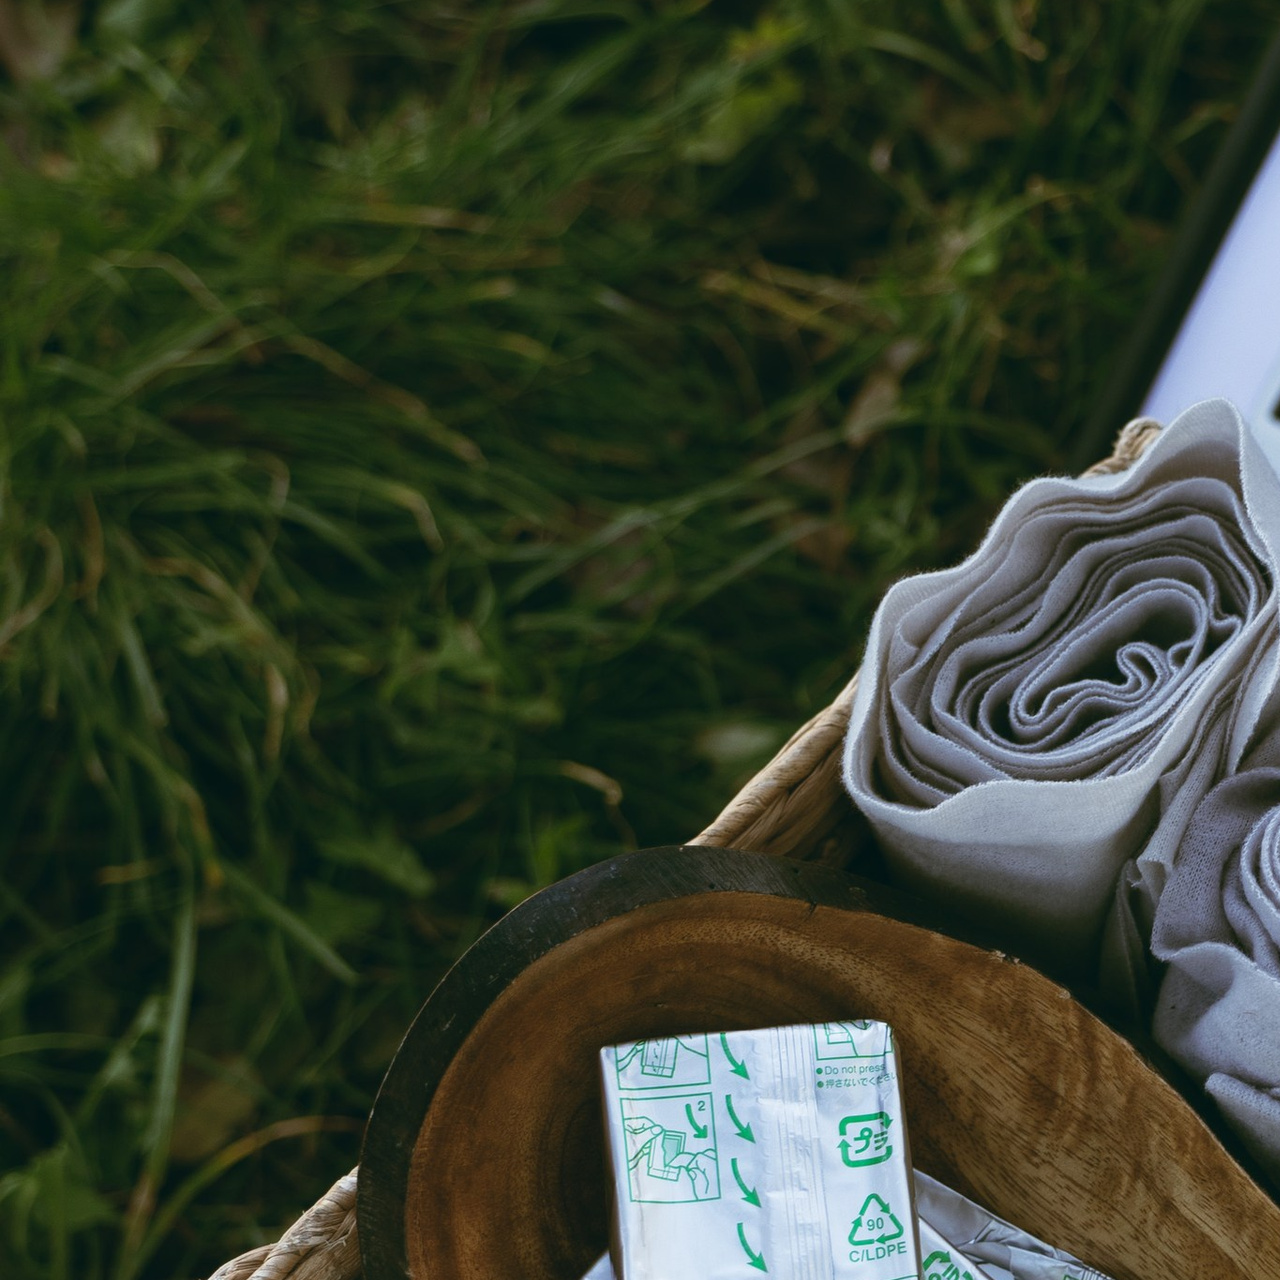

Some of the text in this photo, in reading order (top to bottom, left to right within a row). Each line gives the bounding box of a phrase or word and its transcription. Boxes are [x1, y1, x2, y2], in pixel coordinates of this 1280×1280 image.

[825, 1066, 839, 1075] Do
[842, 1065, 857, 1074] not
[697, 1100, 706, 1111] 2
[867, 1217, 884, 1231] 90
[849, 1241, 907, 1263] C/LDPE
